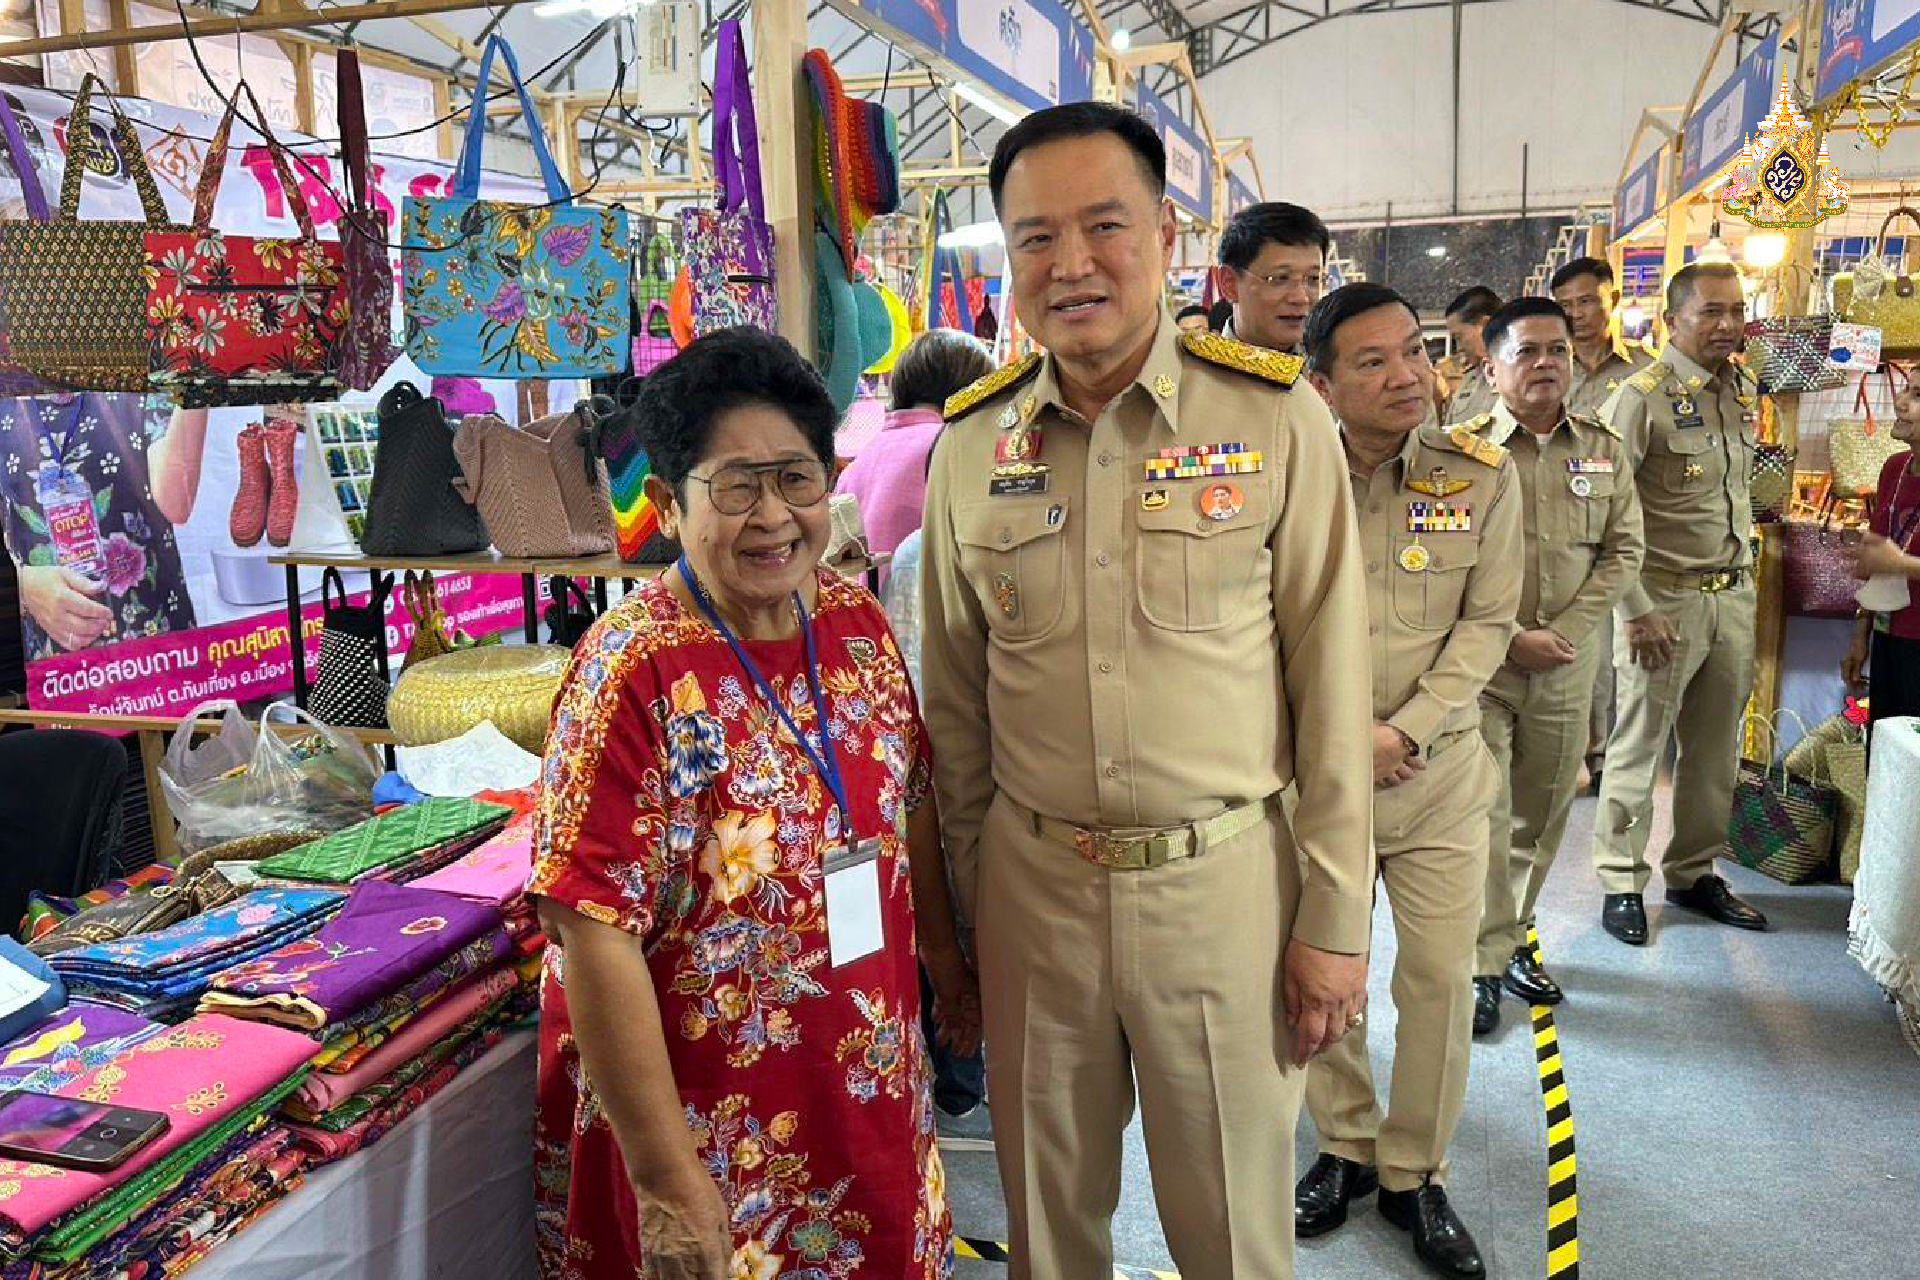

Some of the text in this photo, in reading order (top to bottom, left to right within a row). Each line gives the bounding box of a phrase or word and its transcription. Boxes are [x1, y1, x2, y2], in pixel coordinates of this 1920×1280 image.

[43, 646, 200, 699] ติดต่อสอบถาม
